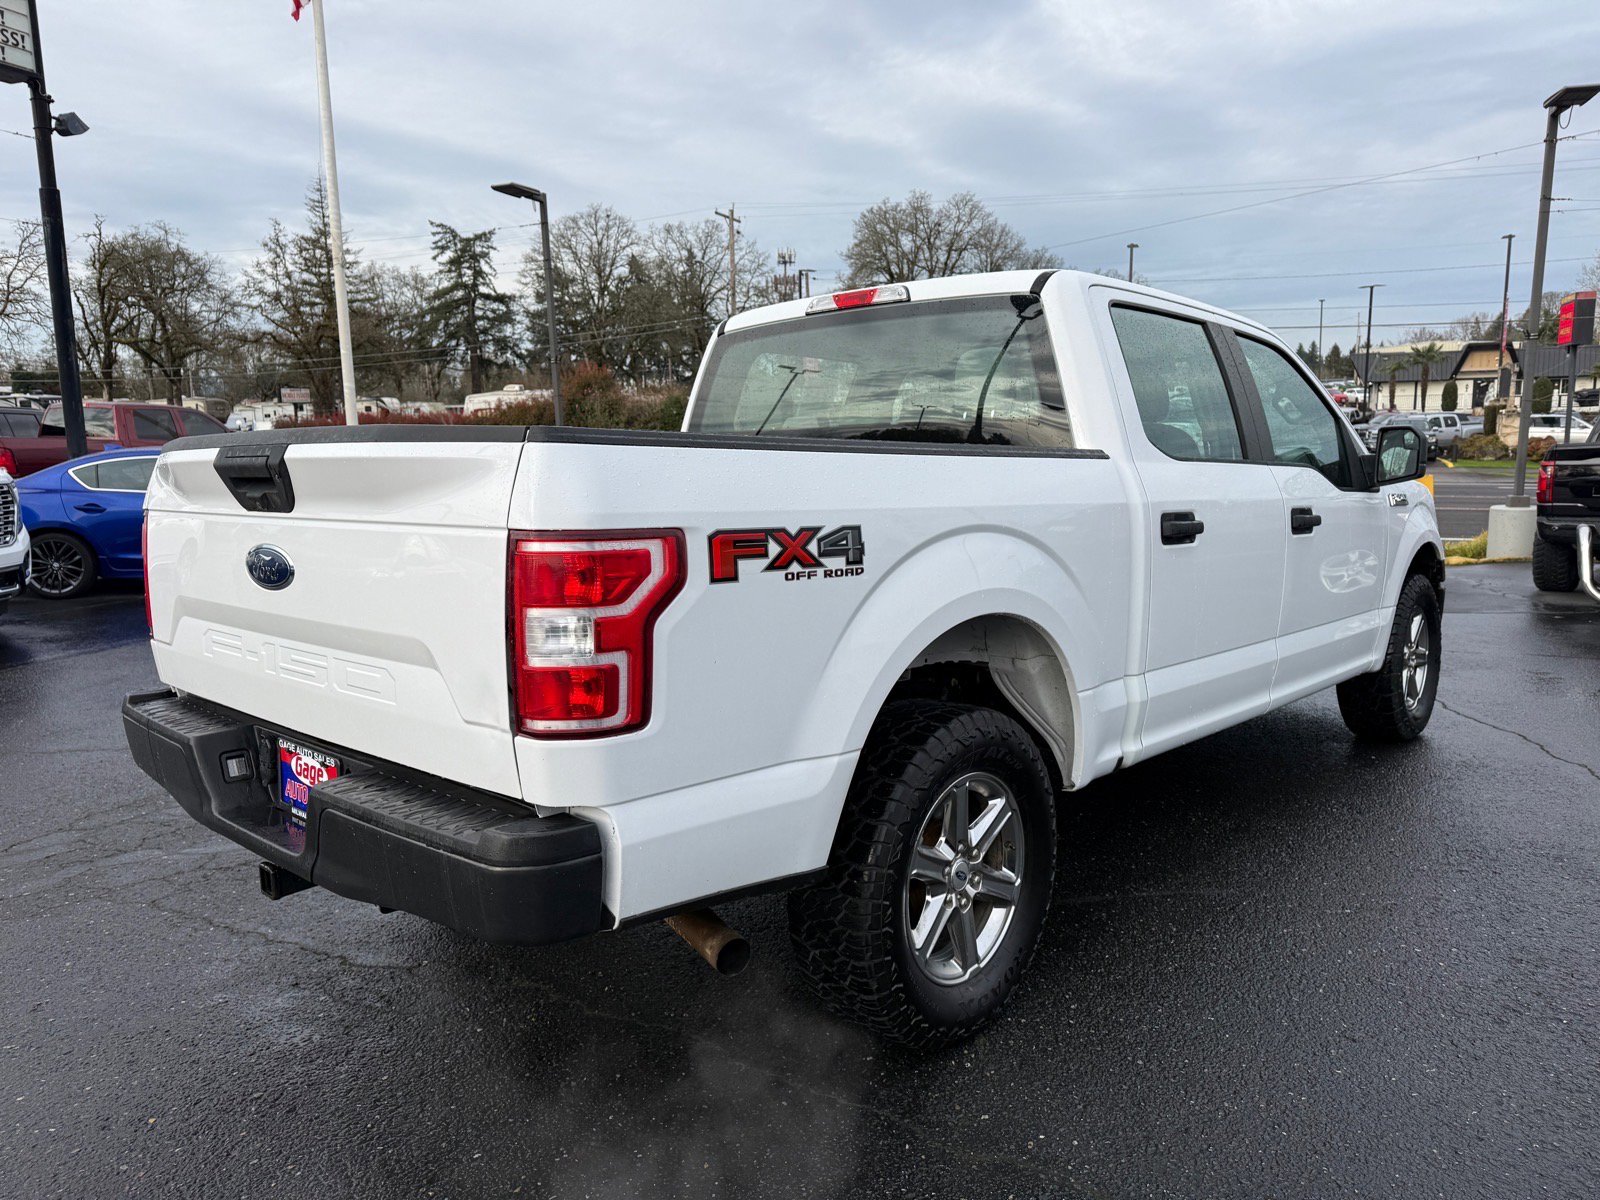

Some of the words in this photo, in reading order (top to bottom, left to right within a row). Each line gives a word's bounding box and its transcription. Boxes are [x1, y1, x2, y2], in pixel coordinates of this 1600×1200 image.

[706, 525, 865, 585] FX4
[785, 571, 818, 581] OFF
[823, 567, 865, 579] ROAD
[203, 628, 397, 706] F-150
[279, 739, 295, 753] GAGE
[296, 746, 313, 760] AUTO
[314, 752, 335, 768] SALES
[295, 756, 324, 786] Gage
[285, 778, 309, 805] AUTO
